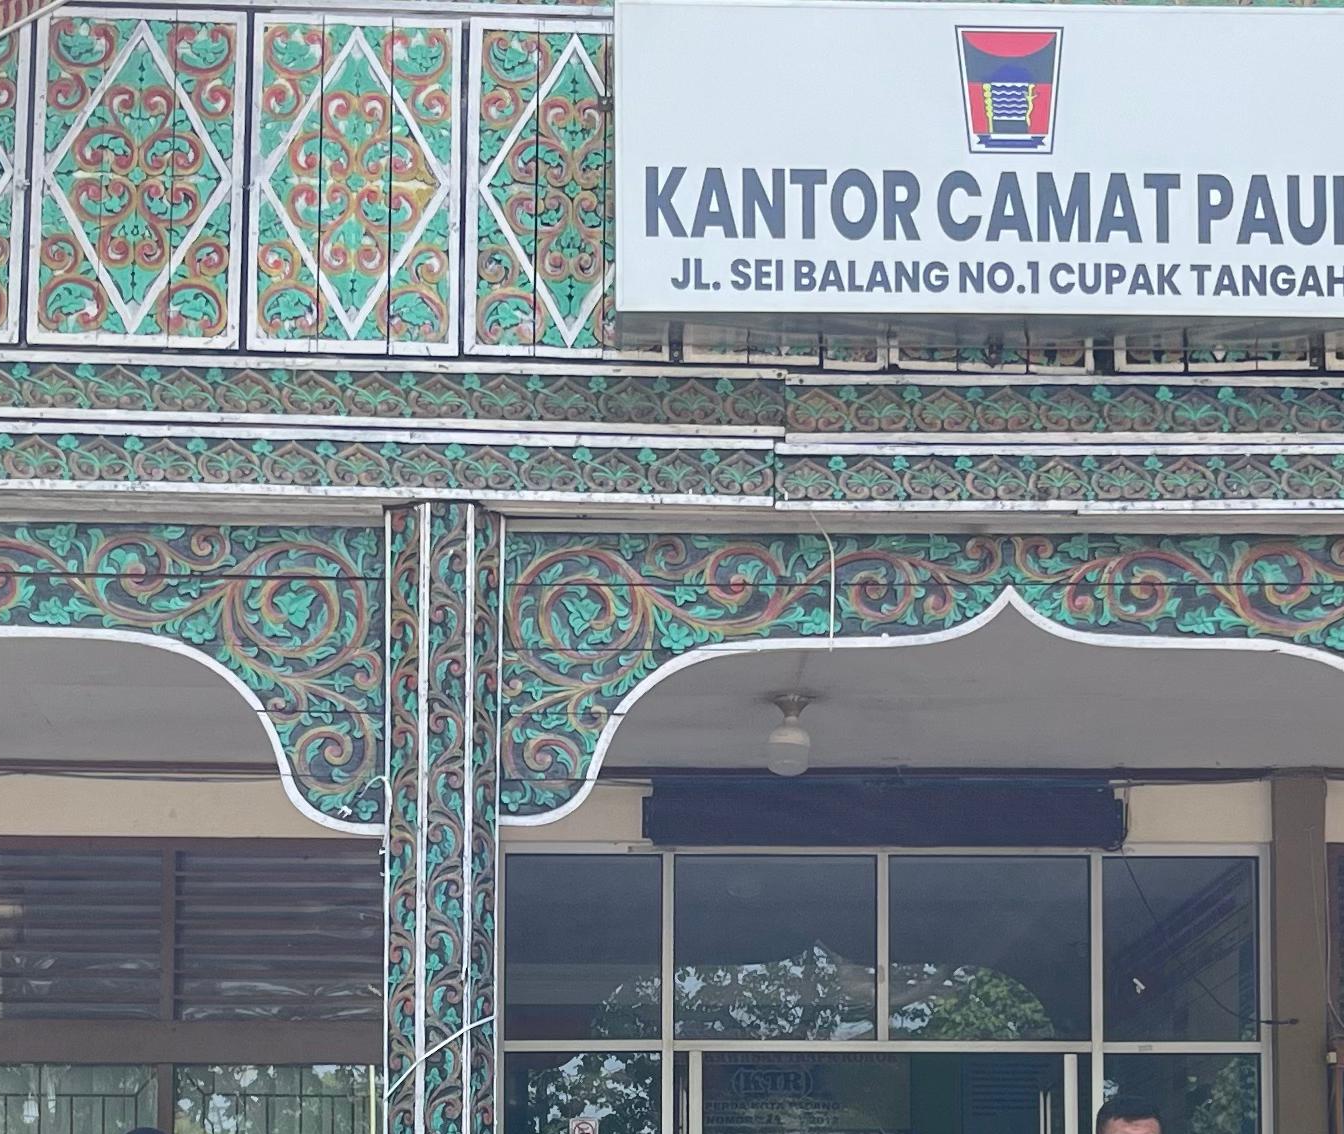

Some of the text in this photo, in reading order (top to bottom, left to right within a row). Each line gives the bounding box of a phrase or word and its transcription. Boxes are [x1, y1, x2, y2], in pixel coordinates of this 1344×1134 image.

[645, 166, 920, 242] KANTOR
[936, 171, 1181, 244] CAMAT
[670, 257, 721, 293] JL.
[730, 259, 784, 293] SEI
[794, 259, 948, 295] BALANG
[958, 261, 1041, 296] NO.1
[1050, 262, 1181, 297] CUPAK
